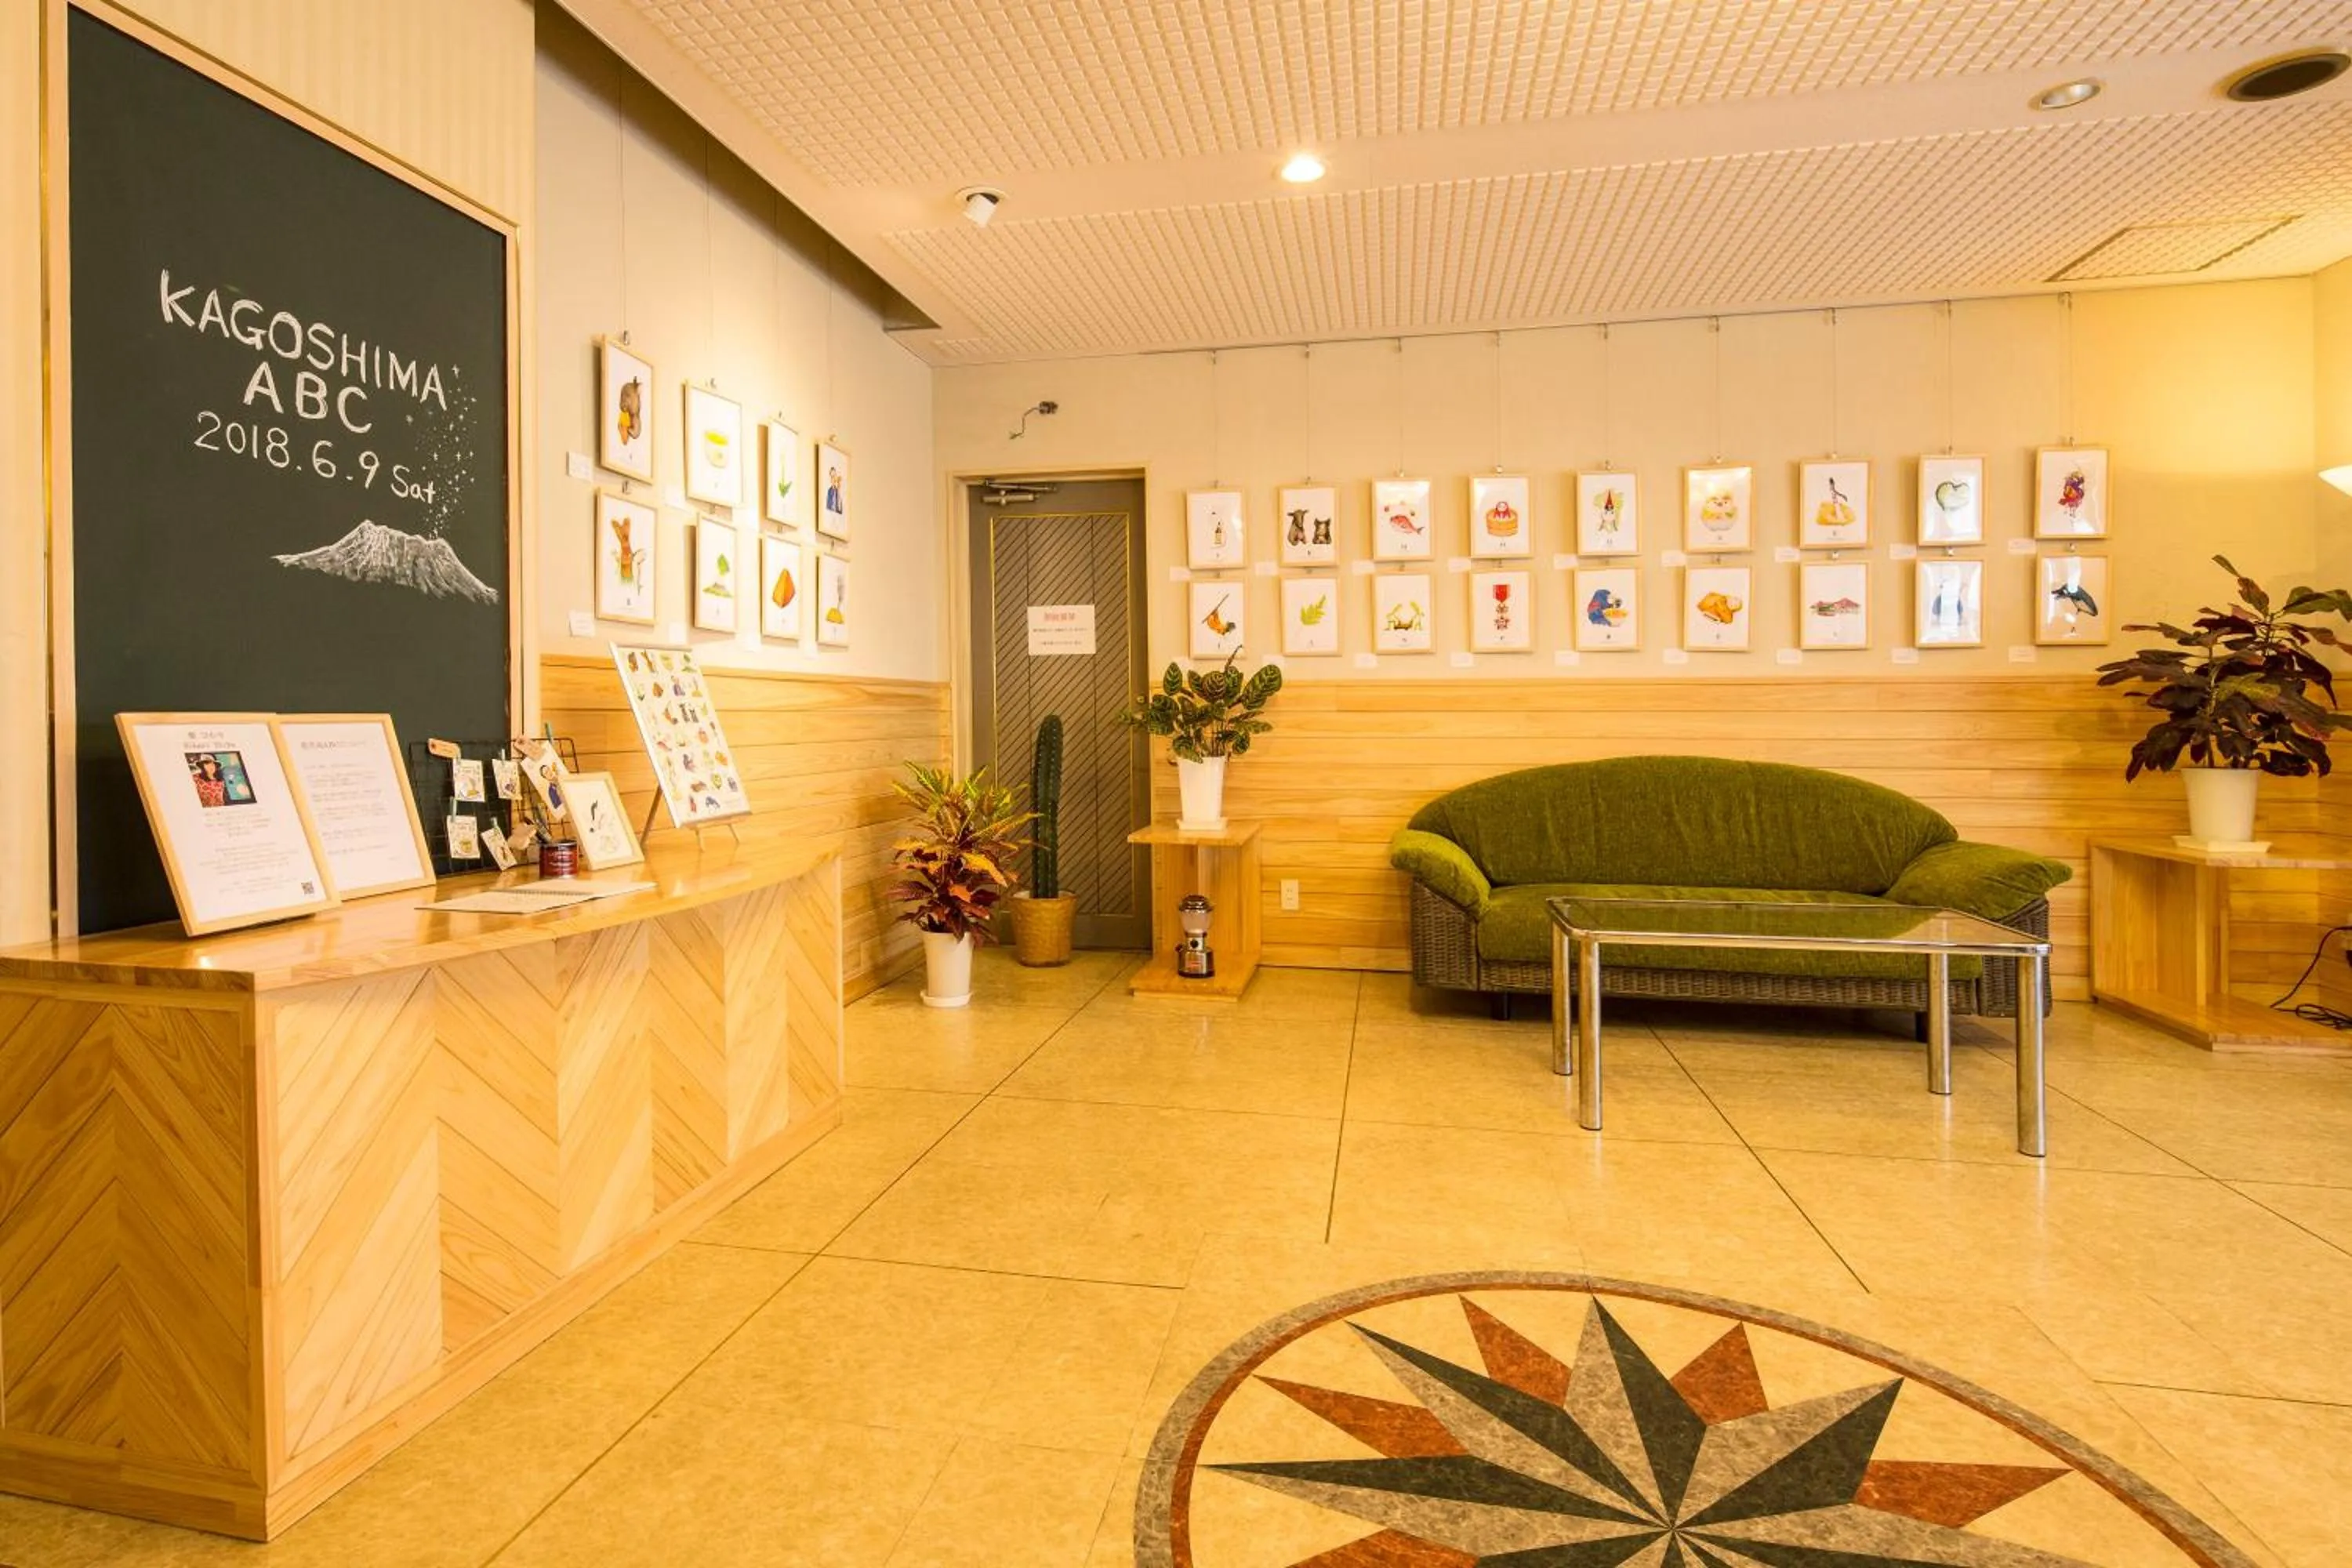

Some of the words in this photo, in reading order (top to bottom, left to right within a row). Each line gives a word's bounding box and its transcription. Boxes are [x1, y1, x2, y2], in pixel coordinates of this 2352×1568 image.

[160, 268, 448, 412] KAGOSHIMA
[243, 361, 373, 434] ABC
[194, 410, 380, 489] 2018.6.9
[390, 464, 436, 504] Sat
